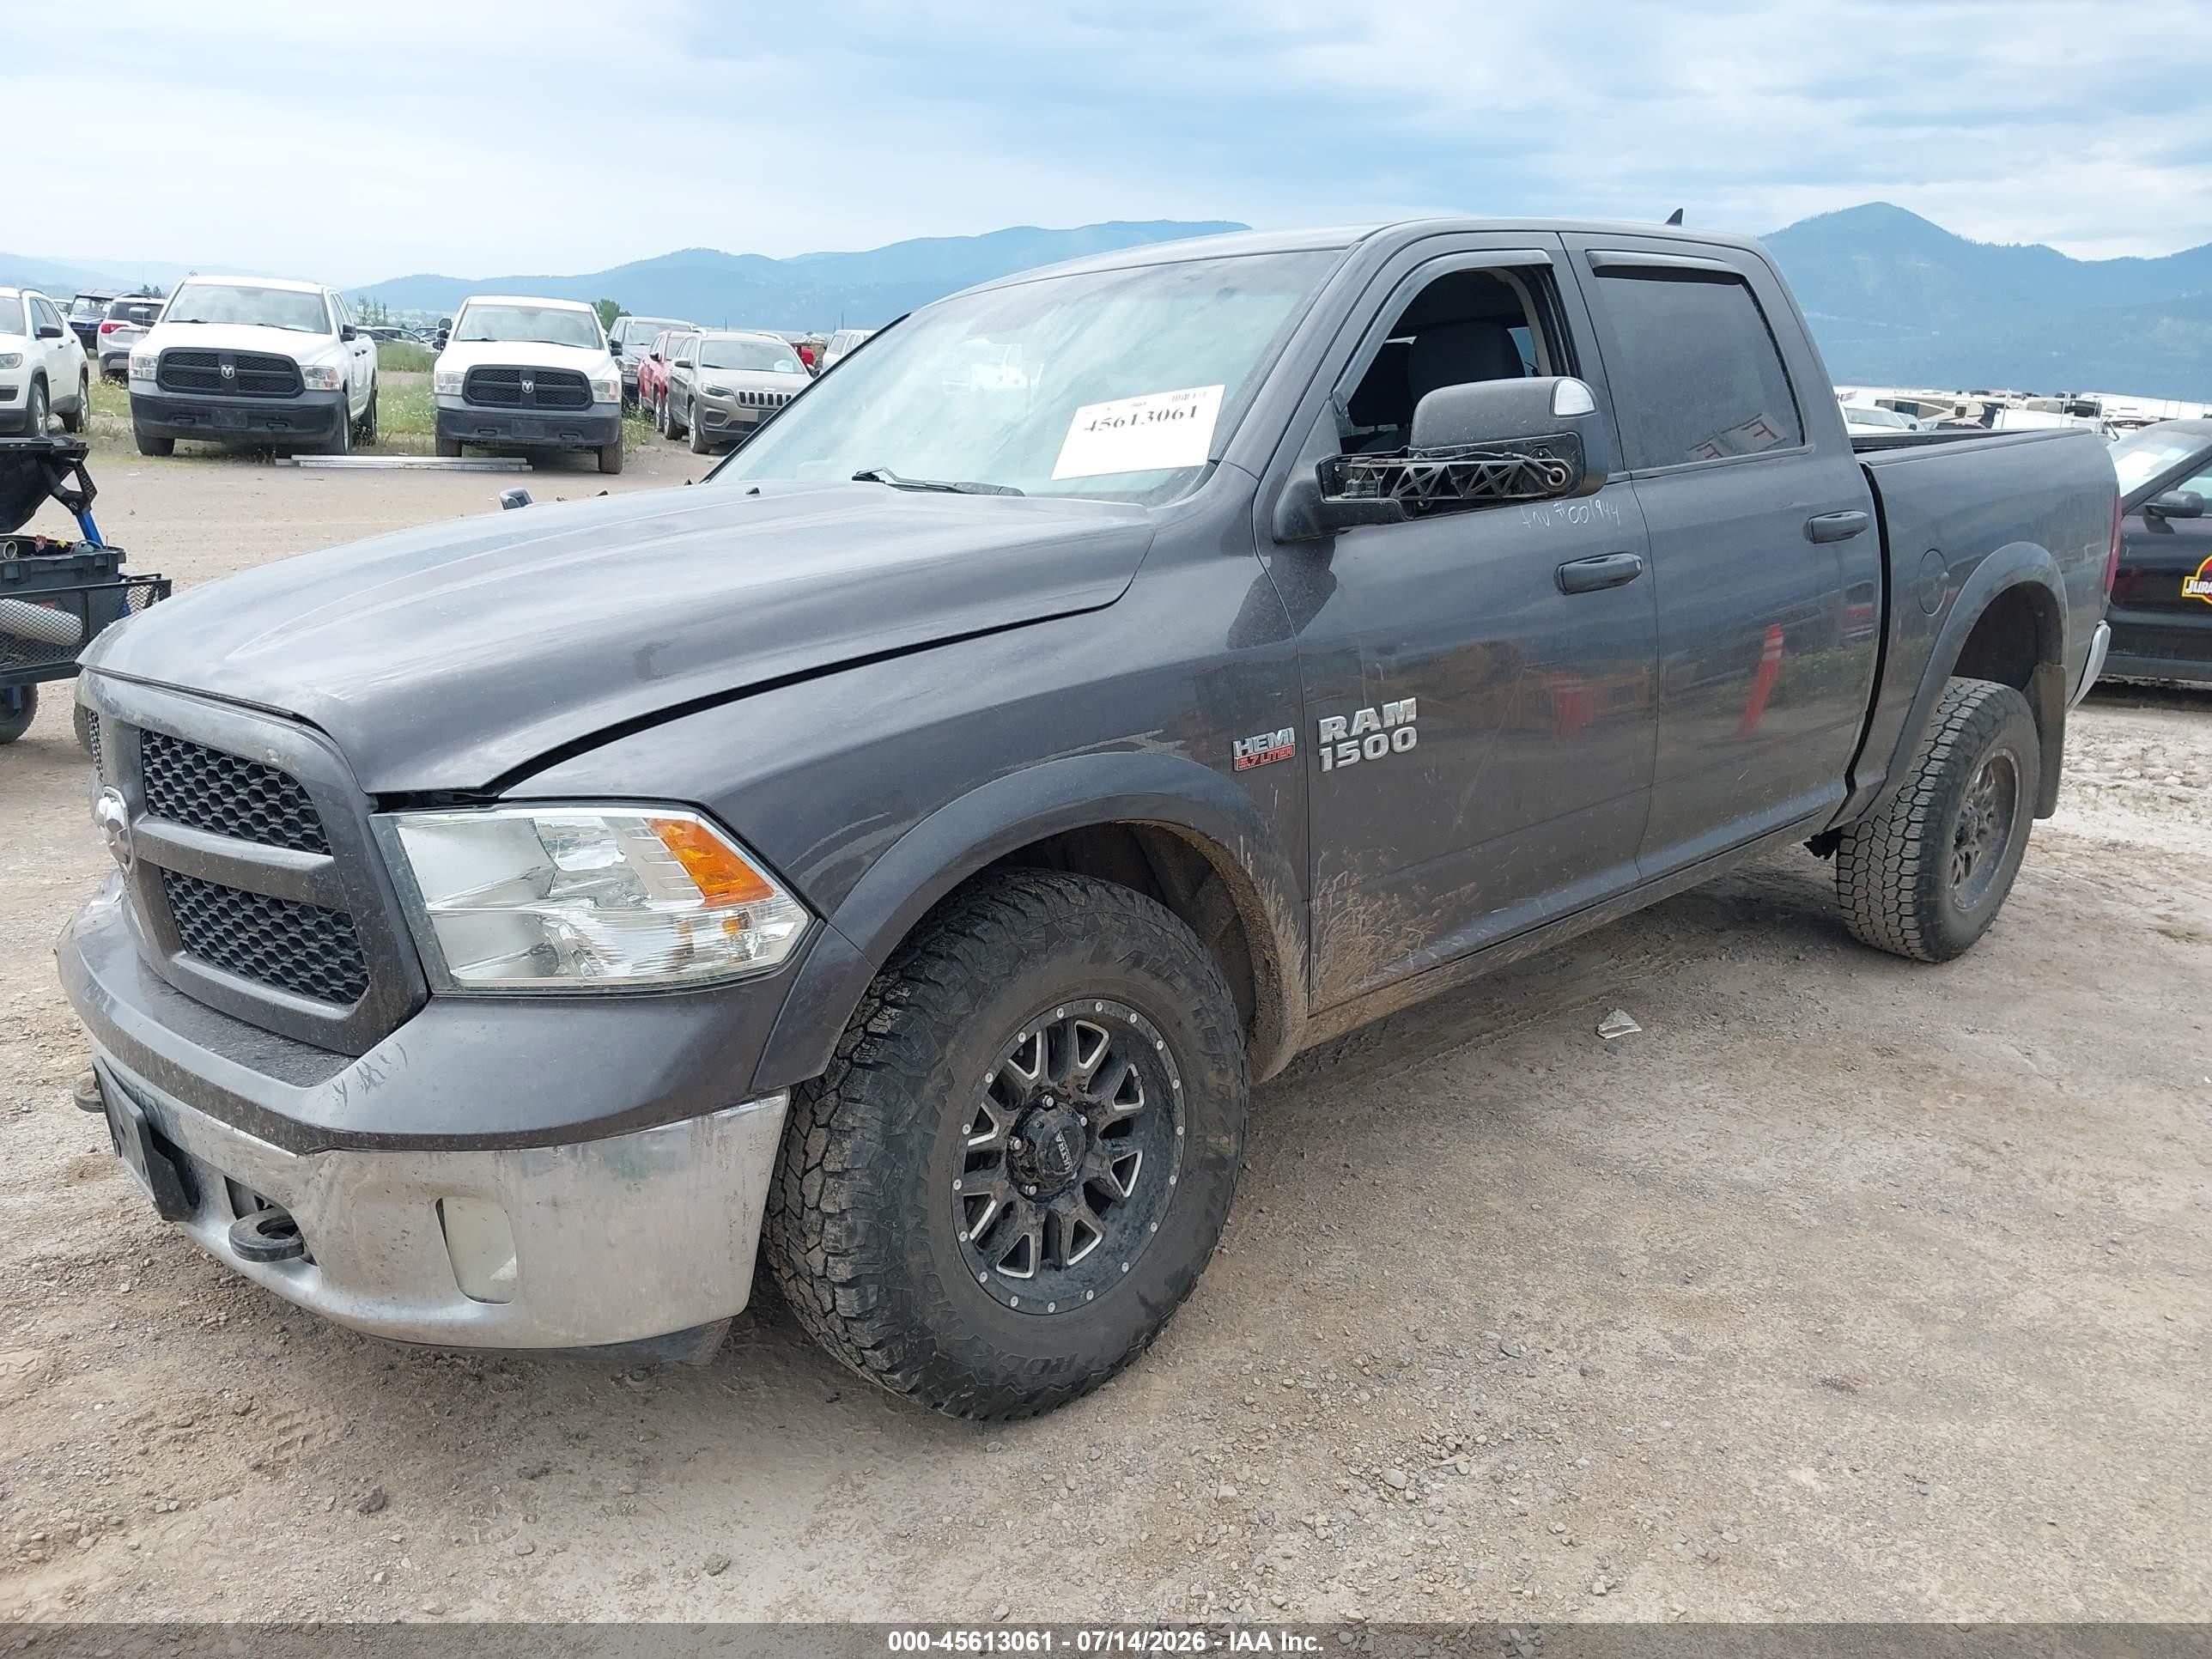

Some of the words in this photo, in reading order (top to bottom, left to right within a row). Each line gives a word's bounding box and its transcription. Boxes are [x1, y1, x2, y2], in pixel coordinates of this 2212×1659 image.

[1084, 405, 1198, 432] 45613061
[1318, 697, 1417, 744] RAM
[1233, 726, 1295, 757] HEMI
[1238, 756, 1259, 769] 5.7
[1260, 745, 1293, 763] LITER
[1319, 726, 1417, 773] 1500
[1055, 1129, 1073, 1170] ULTRA
